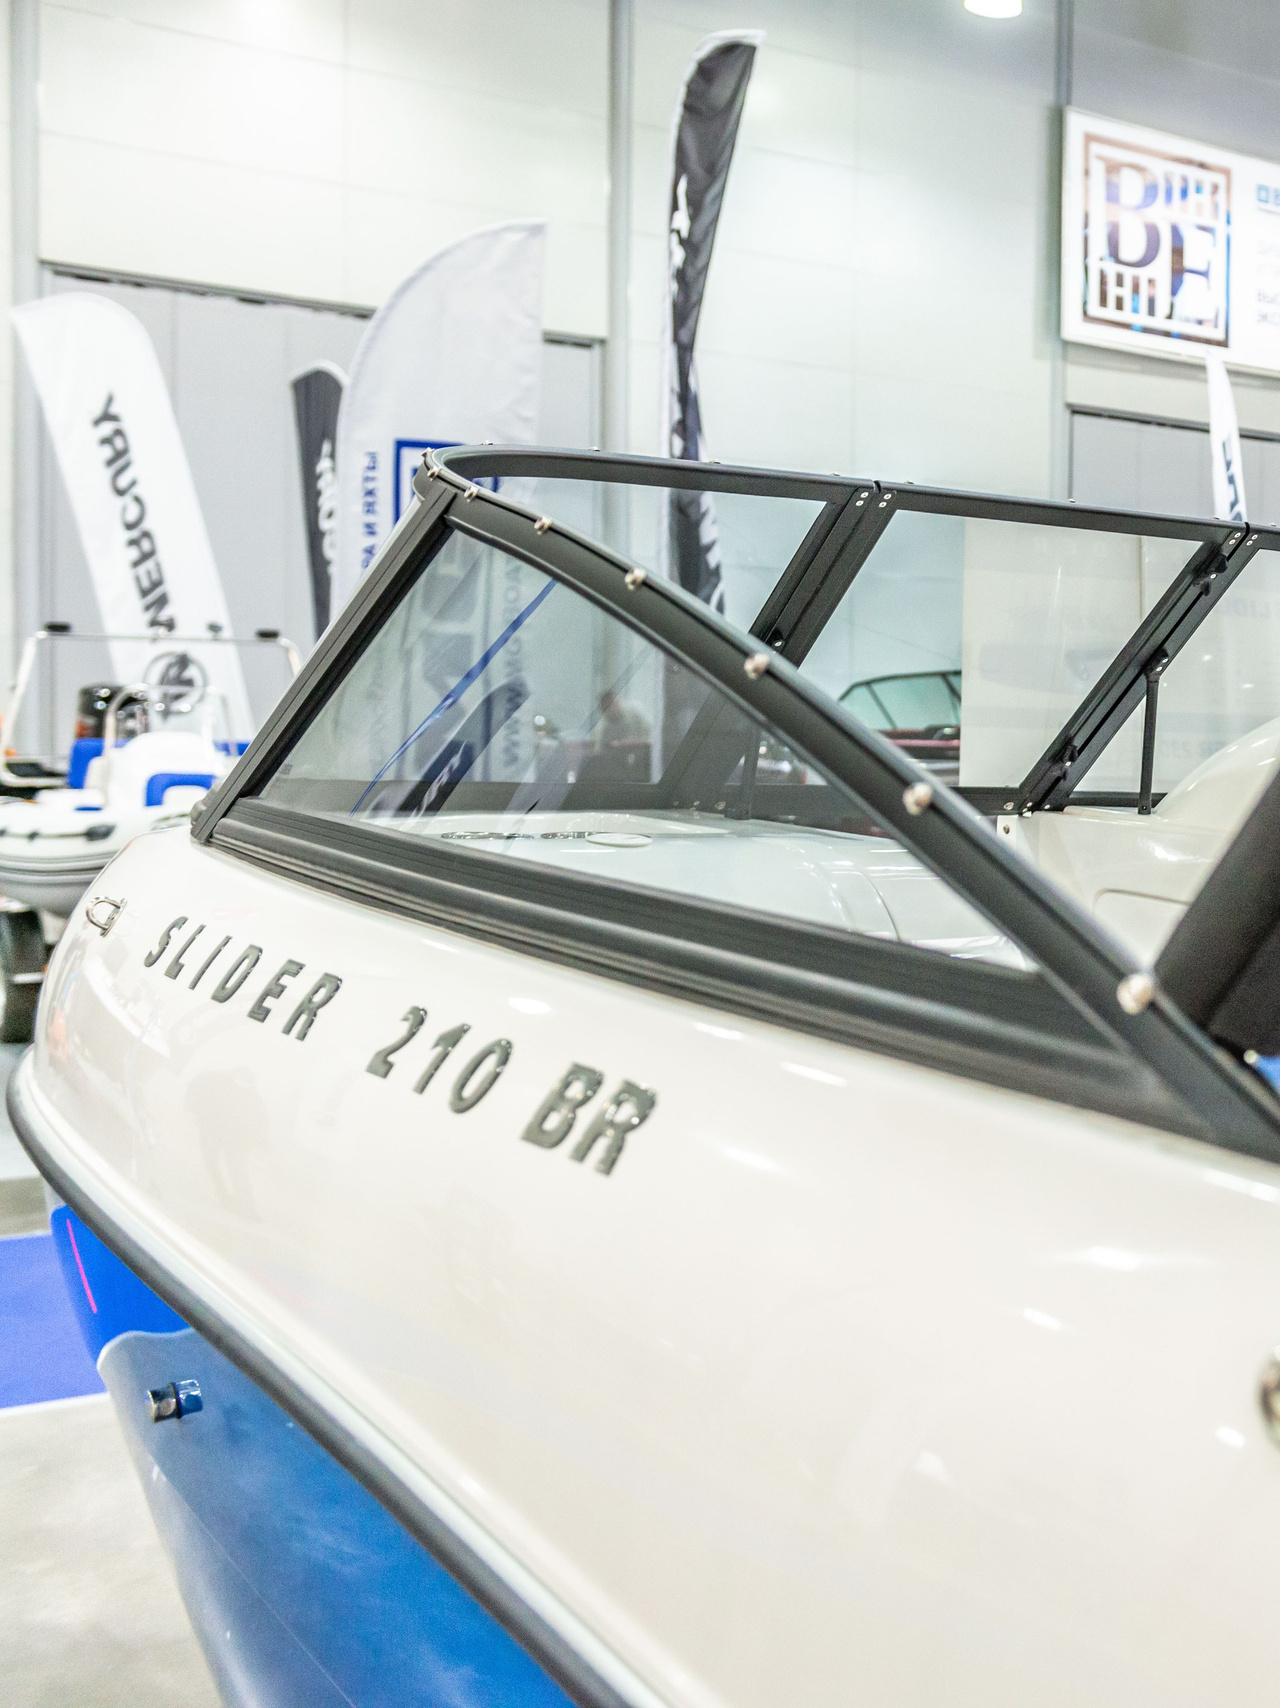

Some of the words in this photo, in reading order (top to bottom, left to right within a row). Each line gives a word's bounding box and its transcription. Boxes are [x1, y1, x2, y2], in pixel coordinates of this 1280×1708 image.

[143, 915, 344, 1042] SLIDER
[364, 1004, 514, 1115] 210
[520, 1061, 660, 1177] BR
